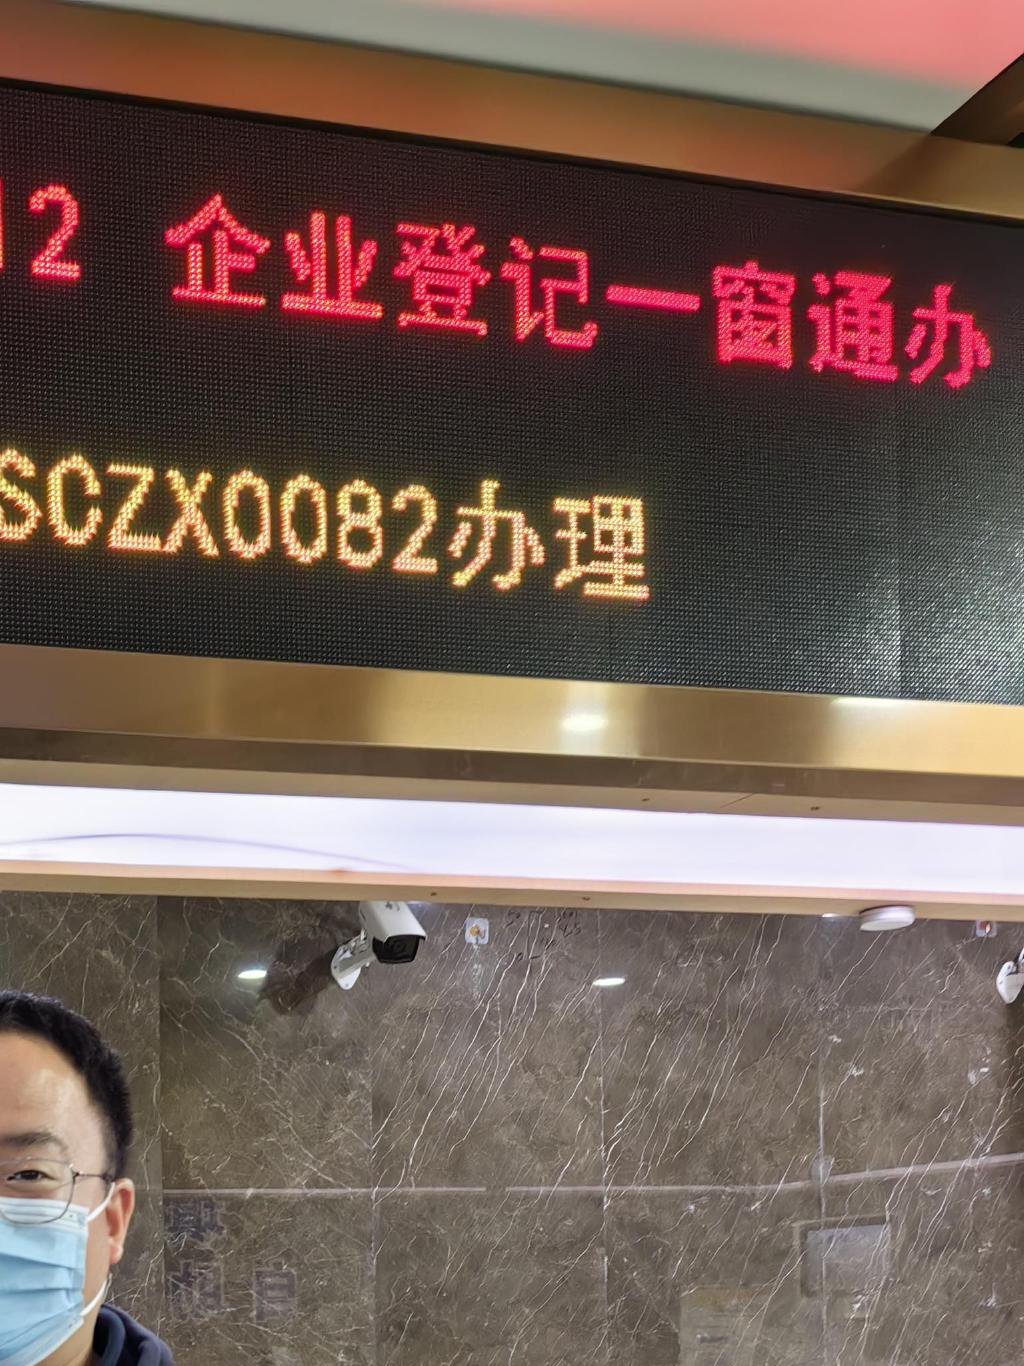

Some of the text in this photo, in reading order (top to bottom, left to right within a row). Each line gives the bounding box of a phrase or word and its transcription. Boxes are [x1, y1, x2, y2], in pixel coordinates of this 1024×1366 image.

[165, 194, 991, 388] 企业登记一窗通办
